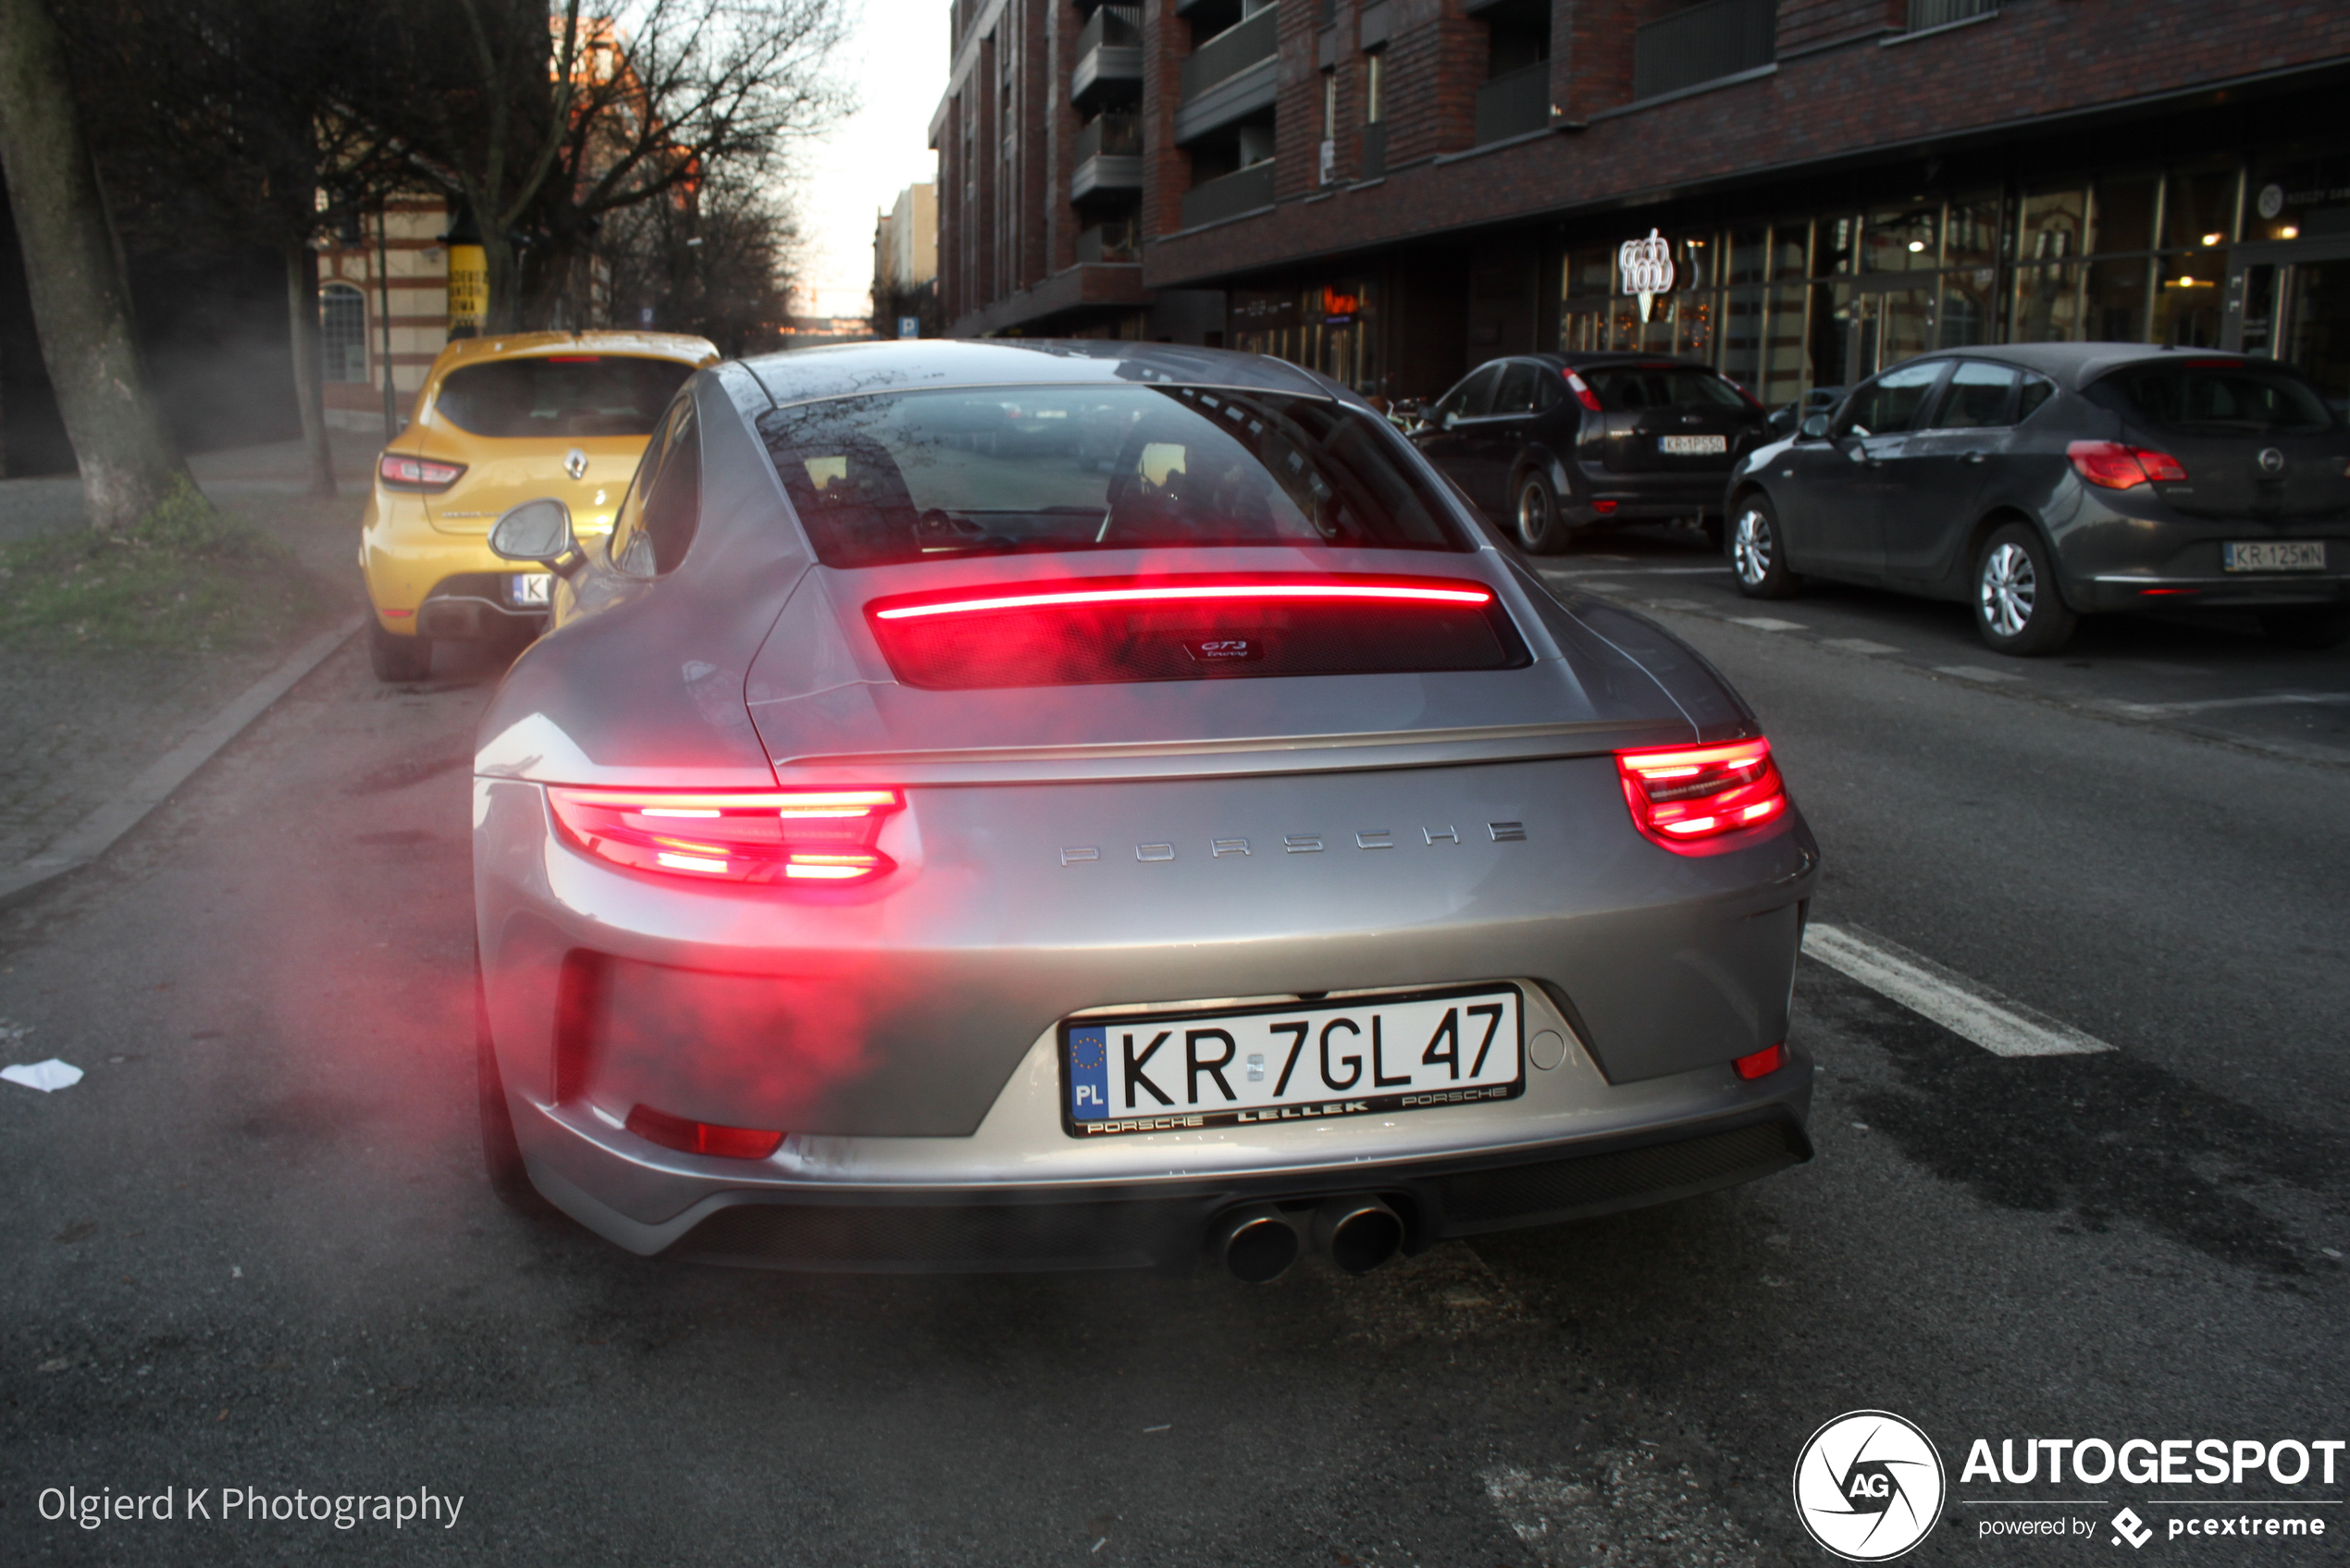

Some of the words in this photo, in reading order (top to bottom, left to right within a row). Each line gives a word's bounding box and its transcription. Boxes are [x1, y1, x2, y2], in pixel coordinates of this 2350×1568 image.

[904, 318, 915, 333] P
[2237, 546, 2261, 564] KR
[2270, 545, 2322, 563] 125WN
[528, 577, 550, 599] K
[1202, 640, 1246, 650] GT3
[1059, 821, 1527, 867] PORSCHE
[1122, 1027, 1238, 1108] KR
[1269, 1003, 1503, 1097] 7GL47
[1076, 1084, 1104, 1105] PL
[1087, 1116, 1204, 1134] PORSCHE
[1237, 1101, 1368, 1122] LELLEK
[1402, 1086, 1508, 1106] PORSCHE
